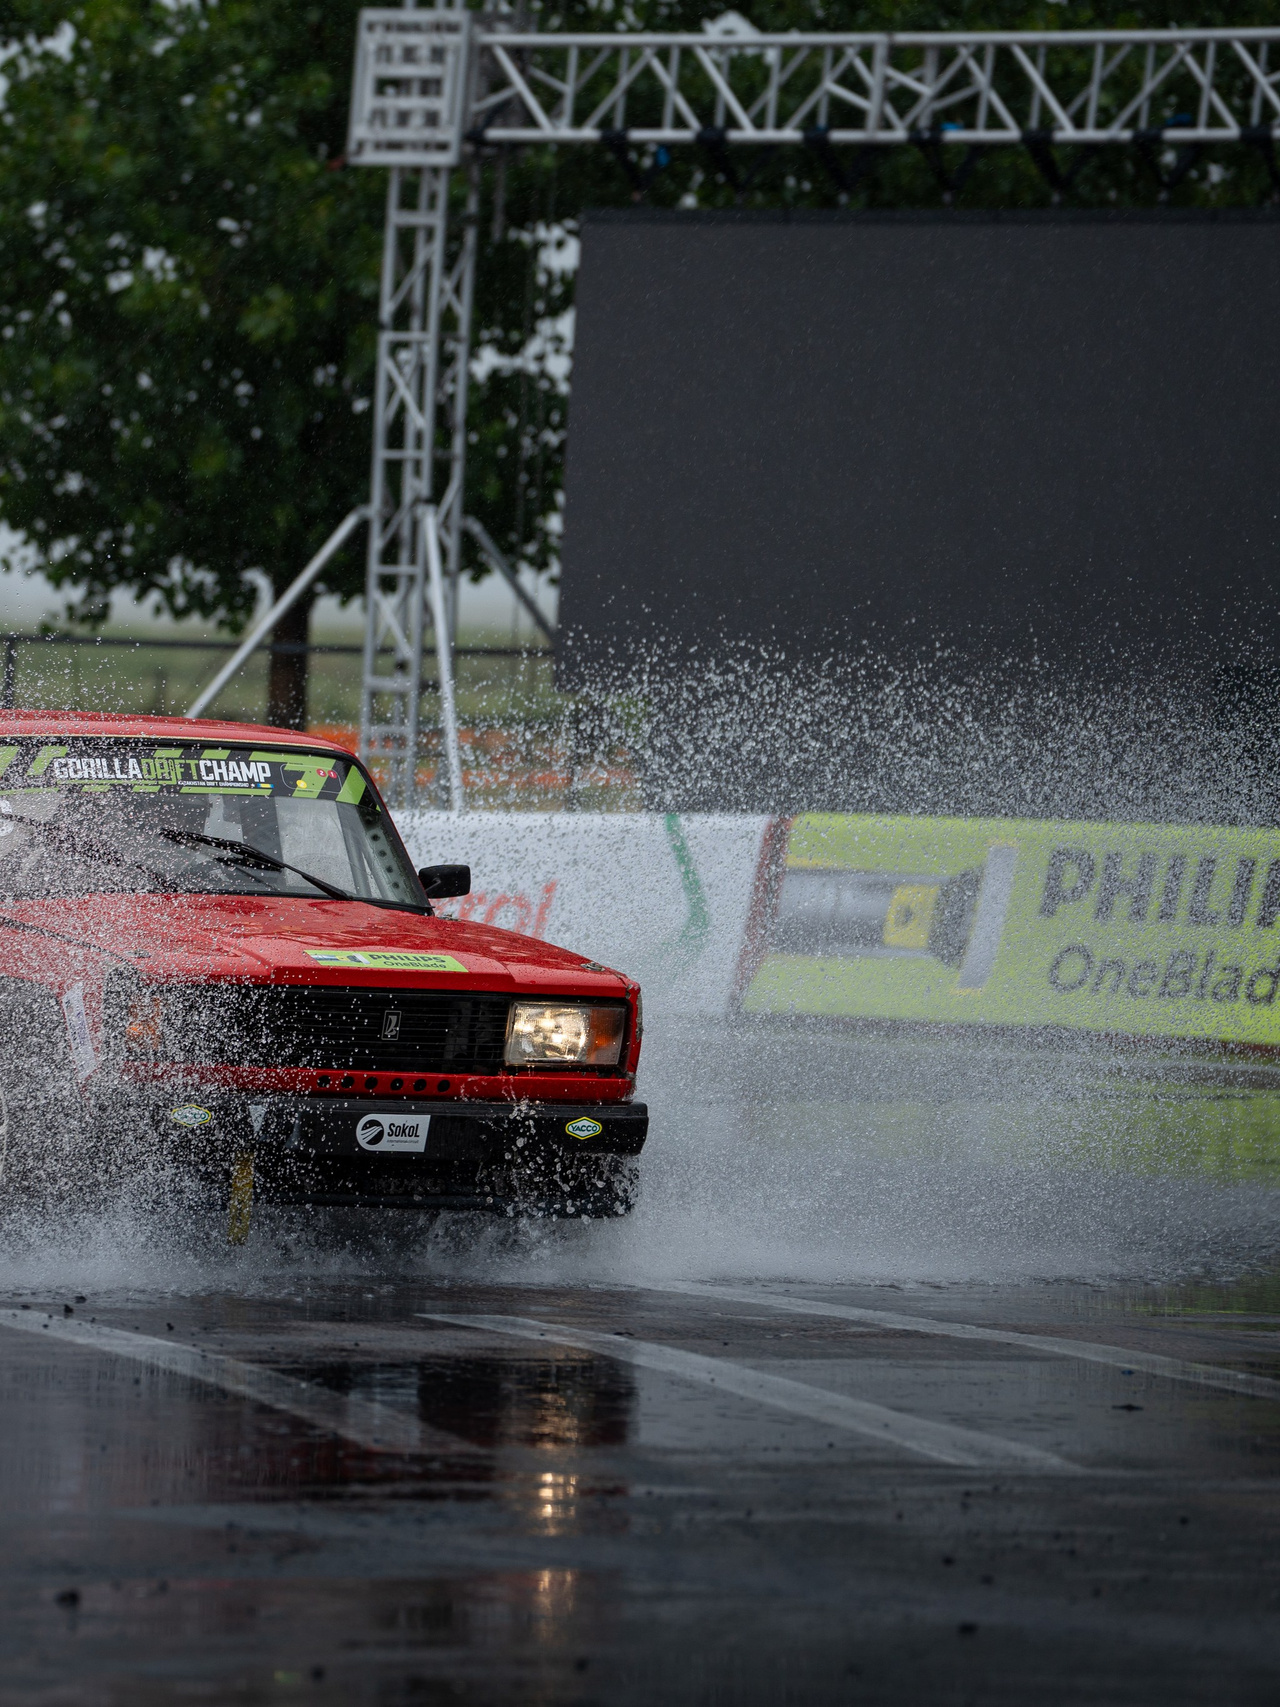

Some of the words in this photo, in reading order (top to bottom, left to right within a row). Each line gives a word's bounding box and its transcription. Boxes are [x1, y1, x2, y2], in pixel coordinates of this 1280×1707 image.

[369, 954, 445, 963] PHILIPS
[383, 960, 447, 969] OneBlade
[571, 1124, 598, 1132] YACCO
